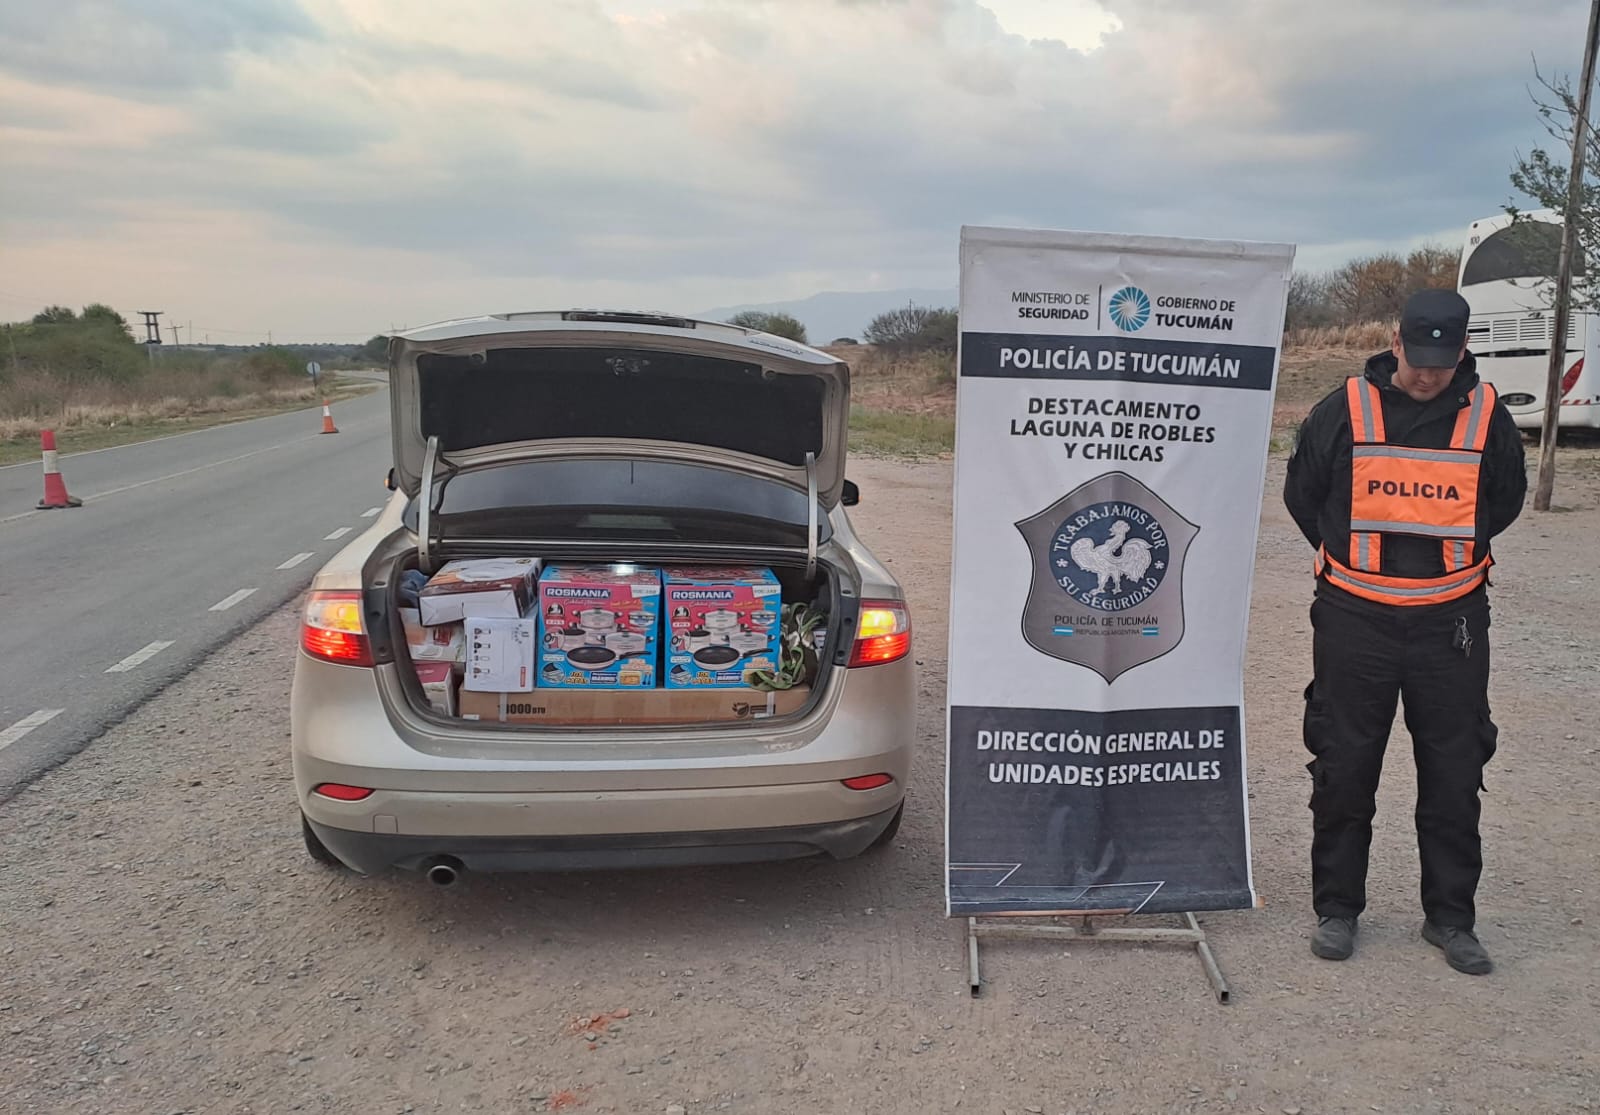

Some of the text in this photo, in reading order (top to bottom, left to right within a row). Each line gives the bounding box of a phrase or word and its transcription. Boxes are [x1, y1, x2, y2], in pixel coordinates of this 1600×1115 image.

[1011, 291, 1090, 304] MINISTERIO DE
[1156, 296, 1235, 312] GOBIERNO DE
[1018, 307, 1089, 320] SEGURIDAD
[1155, 313, 1233, 331] TUCUMÁN
[999, 345, 1241, 378] POLICÍA DE TUCUMÁN
[1028, 398, 1201, 421] DESTACAMENTO
[1010, 419, 1216, 443] LAGUNA DE ROBLES
[1063, 443, 1165, 462] Y CHILCAS
[1367, 480, 1460, 500] POLICIA
[1053, 505, 1166, 552] TRABAJAMOS POR
[547, 588, 609, 598] ROSMANIA
[672, 591, 733, 600] ROSMANIA
[1057, 576, 1158, 611] SU SEGURIDAD
[1054, 615, 1158, 627] POLICÍA DE TUCUMÁN
[977, 730, 1224, 754] DIRECCIÓN GENERAL DE
[988, 761, 1220, 786] UNIDADES ESPECIALES
